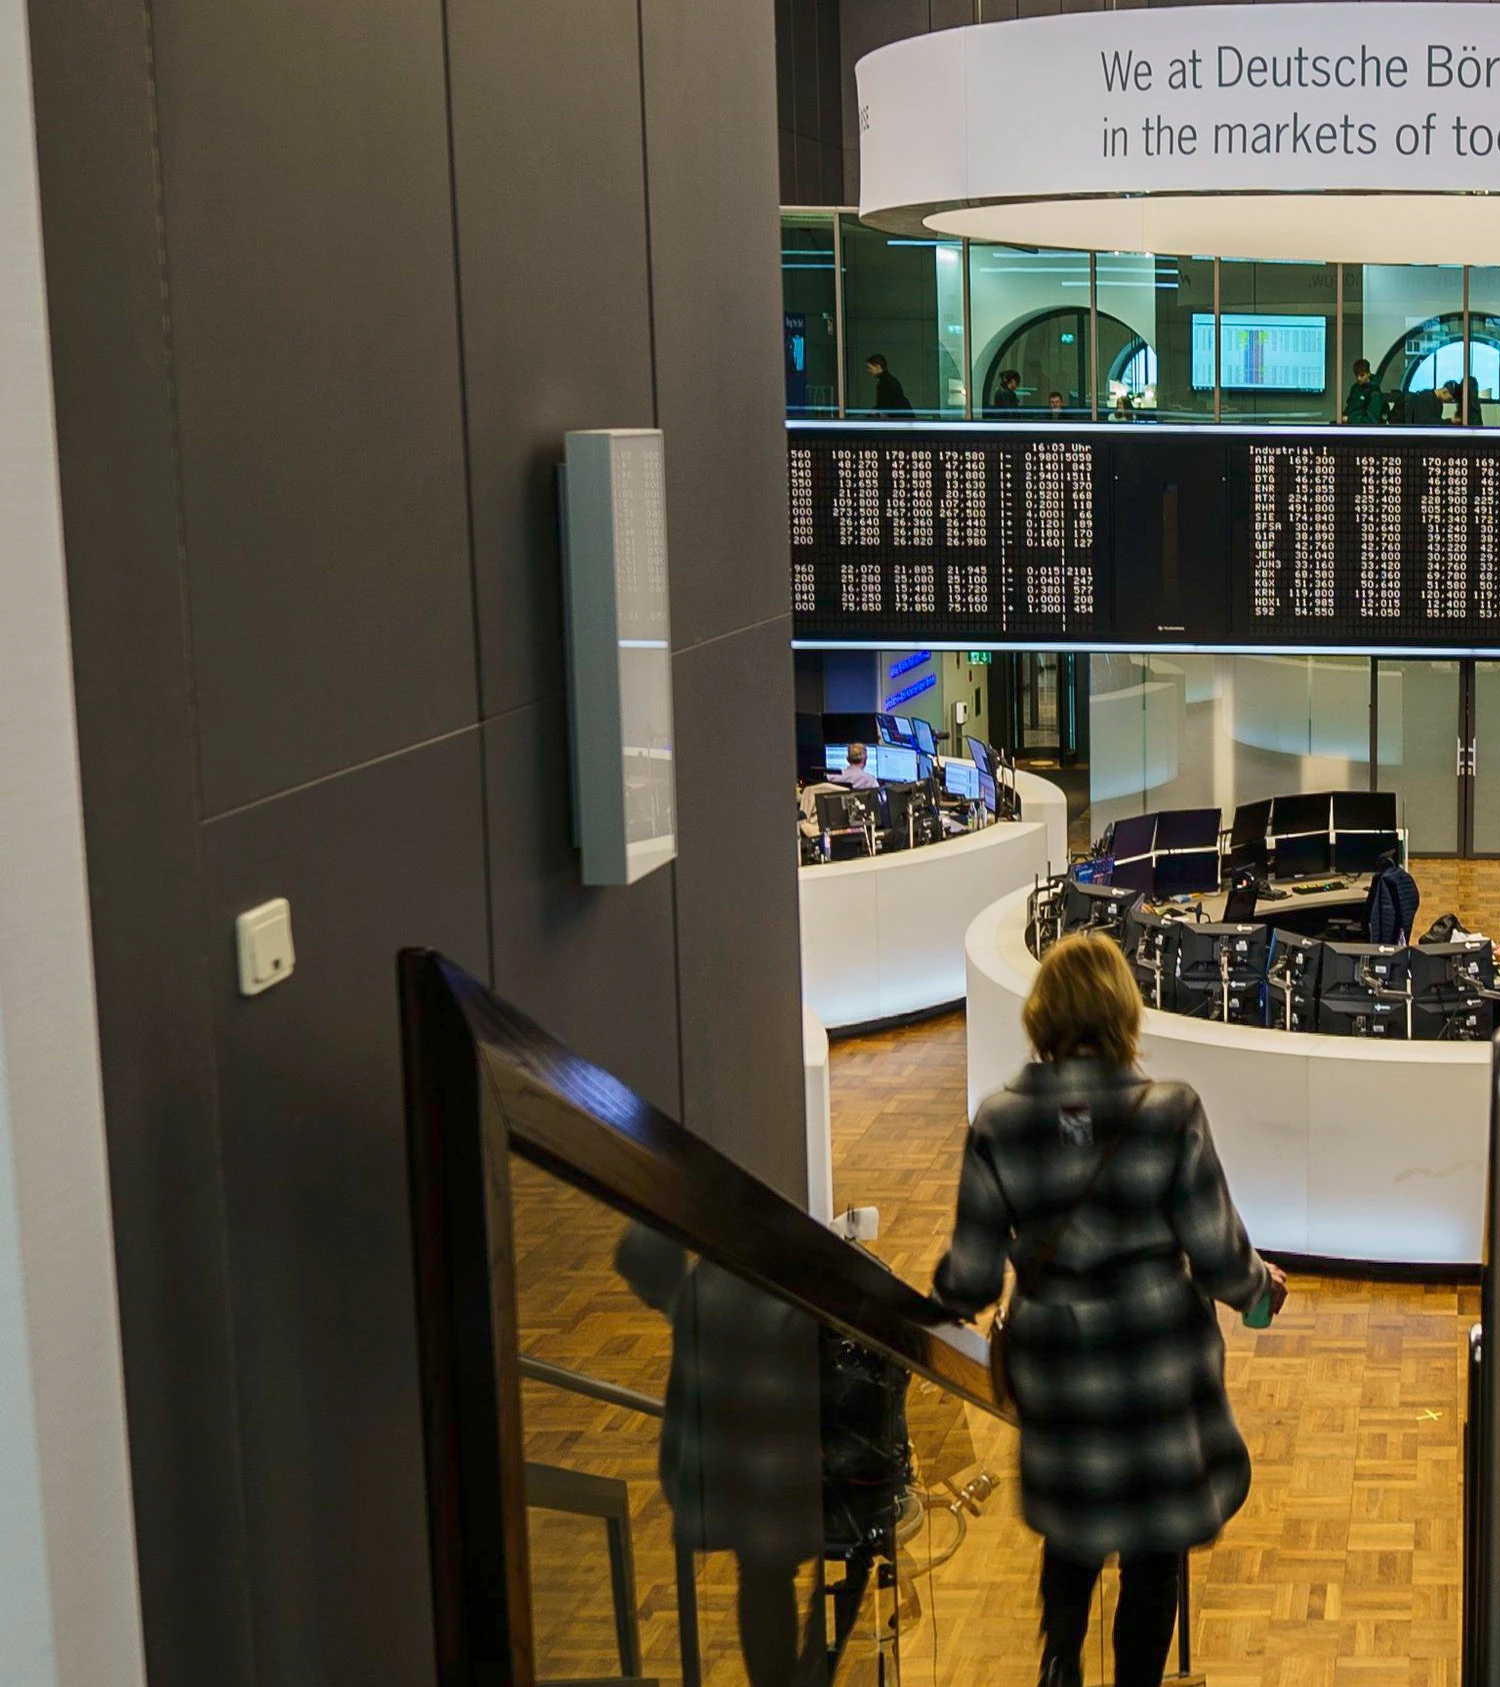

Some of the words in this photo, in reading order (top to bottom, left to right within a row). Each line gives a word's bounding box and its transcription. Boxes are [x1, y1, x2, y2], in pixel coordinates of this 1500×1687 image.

[1101, 50, 1152, 92] We
[1169, 50, 1202, 89] at
[1218, 45, 1407, 87] Deutsche
[1104, 117, 1127, 157] in
[1142, 115, 1196, 156] the
[1215, 112, 1376, 154] markets
[1396, 113, 1436, 155] of
[1249, 446, 1313, 454] Industrial
[892, 461, 931, 469] 47,360
[1295, 475, 1334, 483] 46,670
[840, 479, 878, 487] 13,655
[894, 480, 931, 488] 13,505
[947, 480, 985, 489] 13,630
[893, 489, 932, 498] 20,460
[946, 490, 985, 498] 20,560
[1255, 485, 1274, 493] ENR
[1363, 486, 1401, 494] 15,790
[887, 499, 932, 507] 106,000
[833, 507, 879, 516] 273,500
[886, 508, 932, 517] 267,000
[1355, 504, 1401, 512] 493,700
[1421, 505, 1467, 513] 505,400
[840, 517, 879, 525] 26,640
[893, 518, 932, 526] 26,360
[947, 518, 986, 527] 26,440
[1255, 513, 1274, 521] SIE
[1356, 514, 1400, 522] 174,500
[1423, 515, 1467, 523] 175,340
[1428, 524, 1467, 532] 31,240
[840, 536, 880, 544] 27,200
[1428, 534, 1466, 542] 39,550
[1428, 543, 1466, 551] 43,220
[1256, 551, 1274, 559] JEN
[1295, 551, 1334, 559] 30,040
[841, 564, 880, 573] 22,070
[948, 566, 986, 574] 21,945
[1256, 560, 1281, 568] JUN3
[1296, 560, 1334, 568] 33,160
[1362, 561, 1400, 569] 33,420
[1295, 579, 1334, 587] 51,360
[1361, 580, 1400, 588] 50,640
[949, 585, 987, 593] 15,720
[842, 593, 881, 601] 20,250
[896, 594, 934, 602] 19,660
[1422, 591, 1466, 599] 120,400
[949, 604, 987, 612] 75,100
[1428, 600, 1466, 608] 12,400
[1255, 607, 1274, 615] S92
[1295, 608, 1334, 616] 54,550
[1361, 608, 1400, 616] 54,050
[1427, 610, 1466, 618] 55,900
